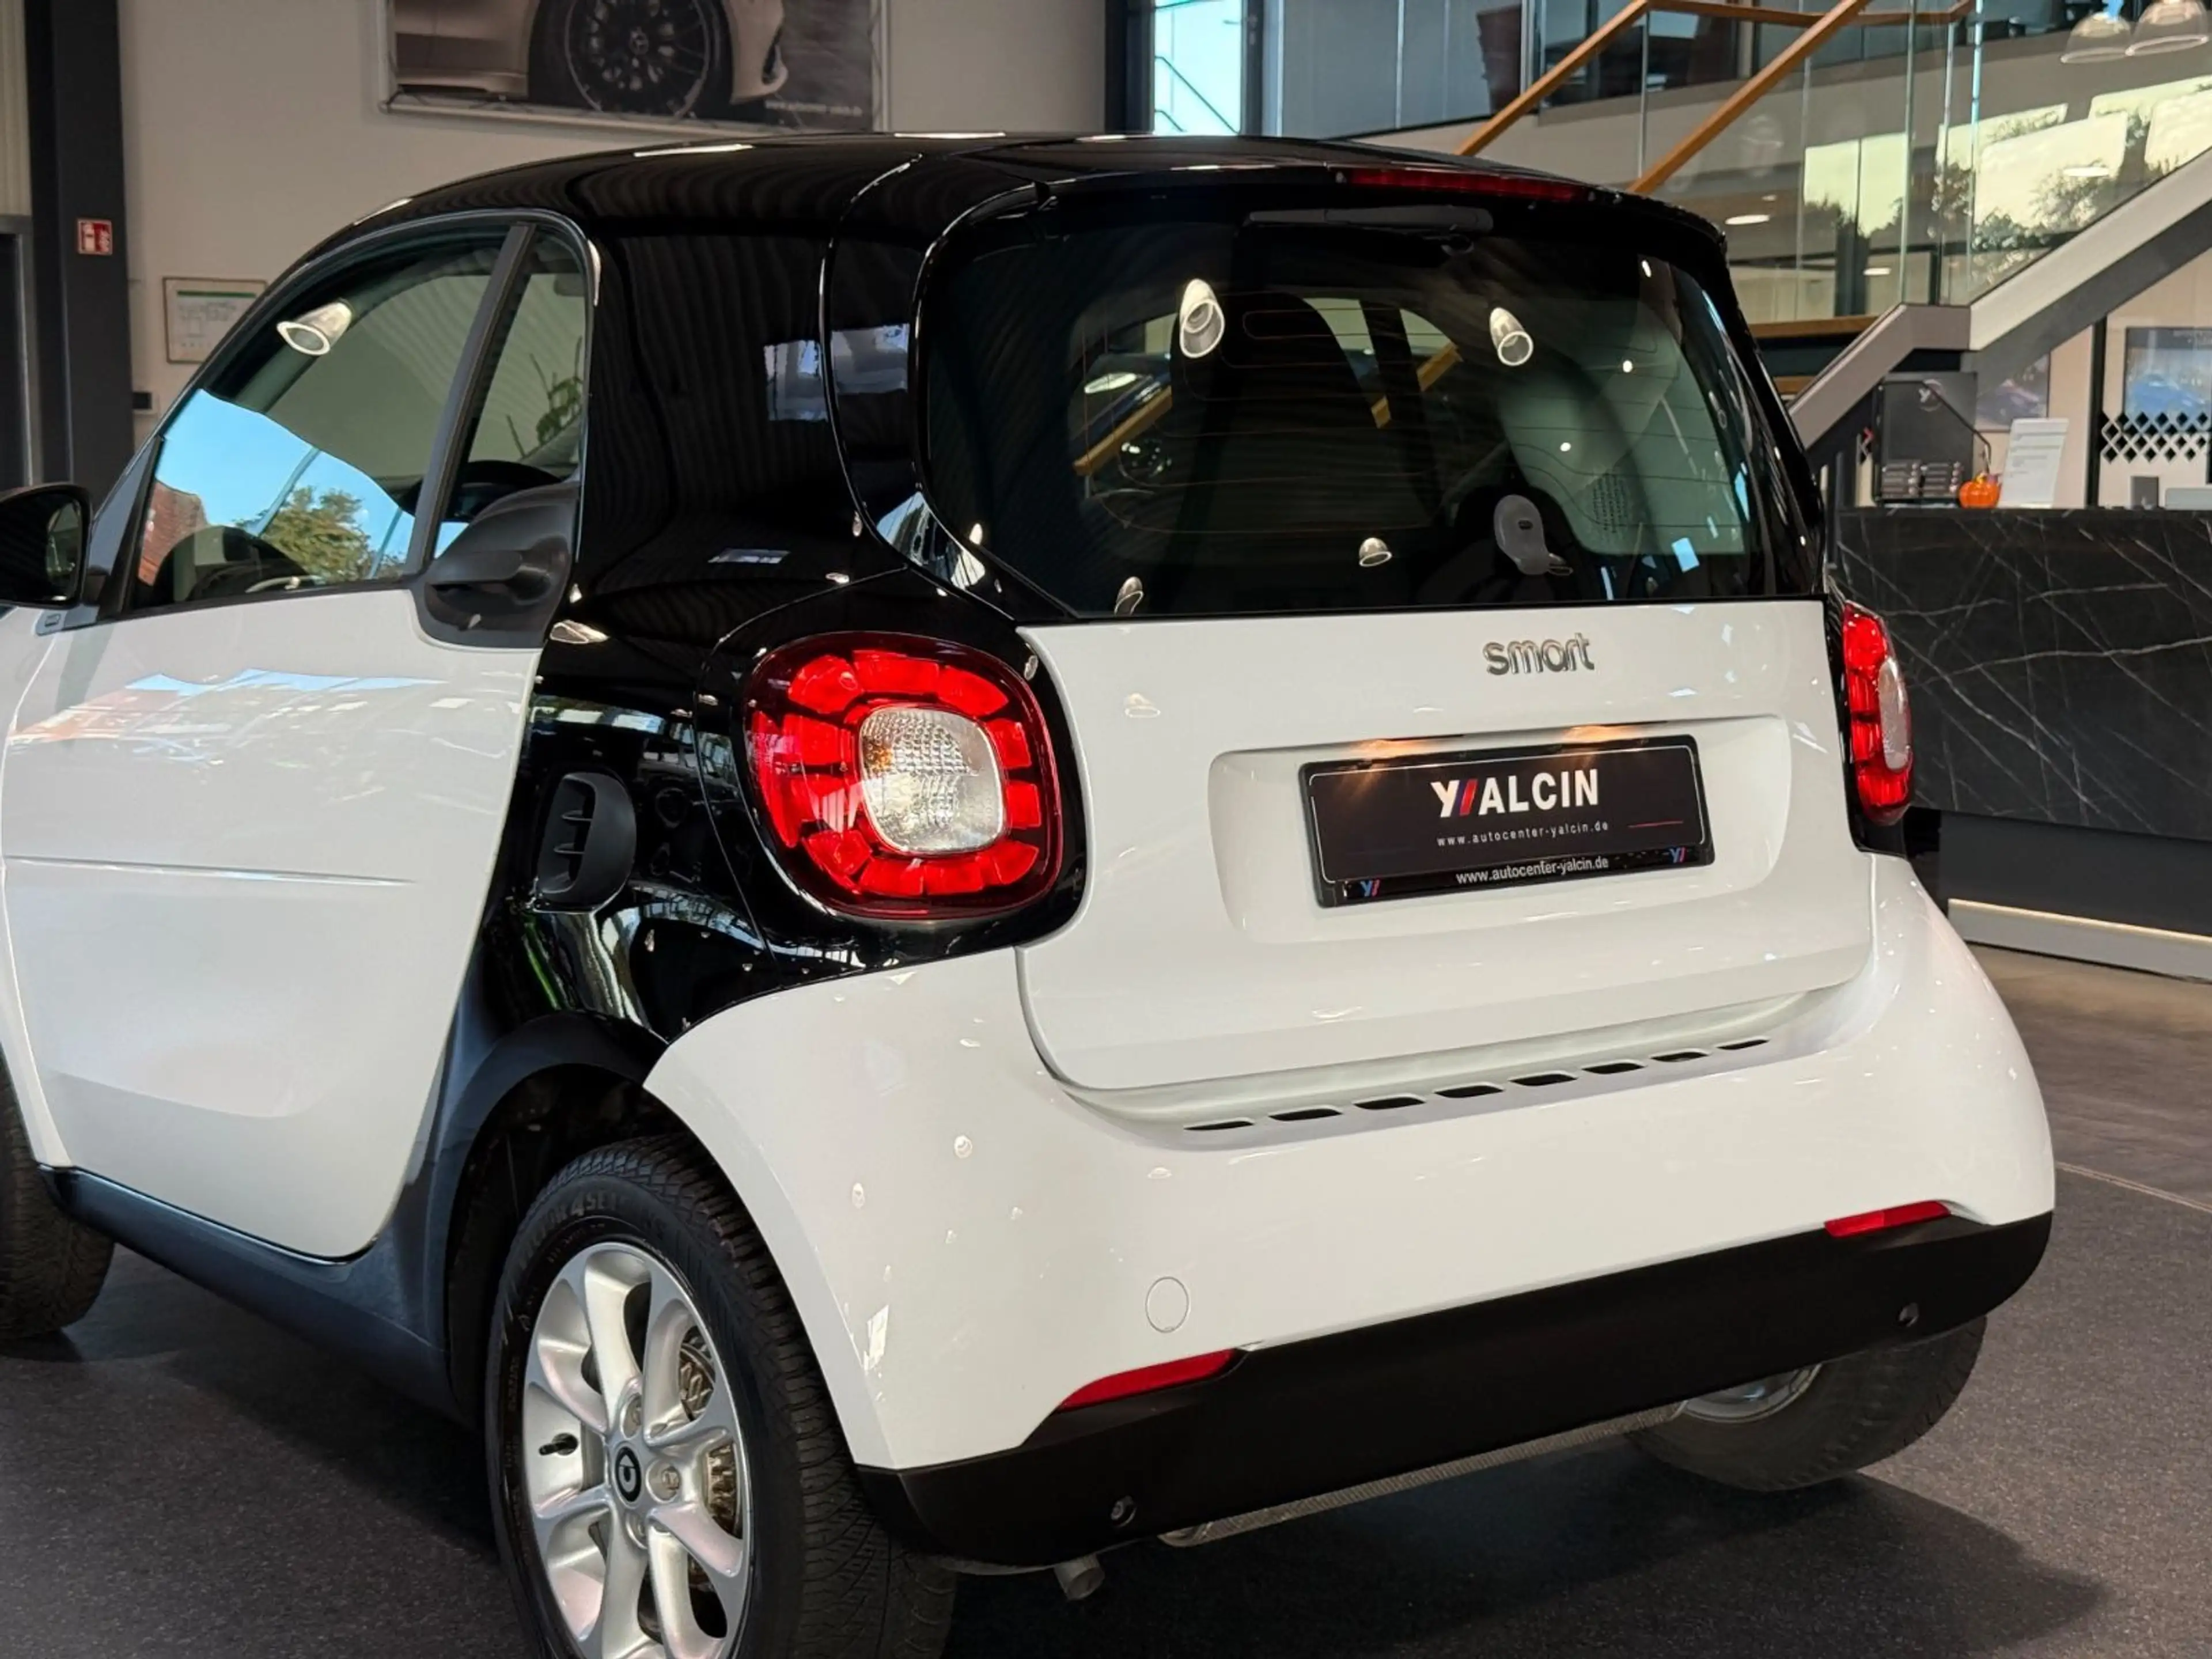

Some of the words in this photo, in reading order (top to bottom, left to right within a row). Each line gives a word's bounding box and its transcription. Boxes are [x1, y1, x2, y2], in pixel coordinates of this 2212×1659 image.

[1482, 632, 1594, 675] smart
[1437, 820, 1609, 846] www.autocenter-yalcin.de
[1456, 855, 1609, 884] www.autocenter-yalcin.de
